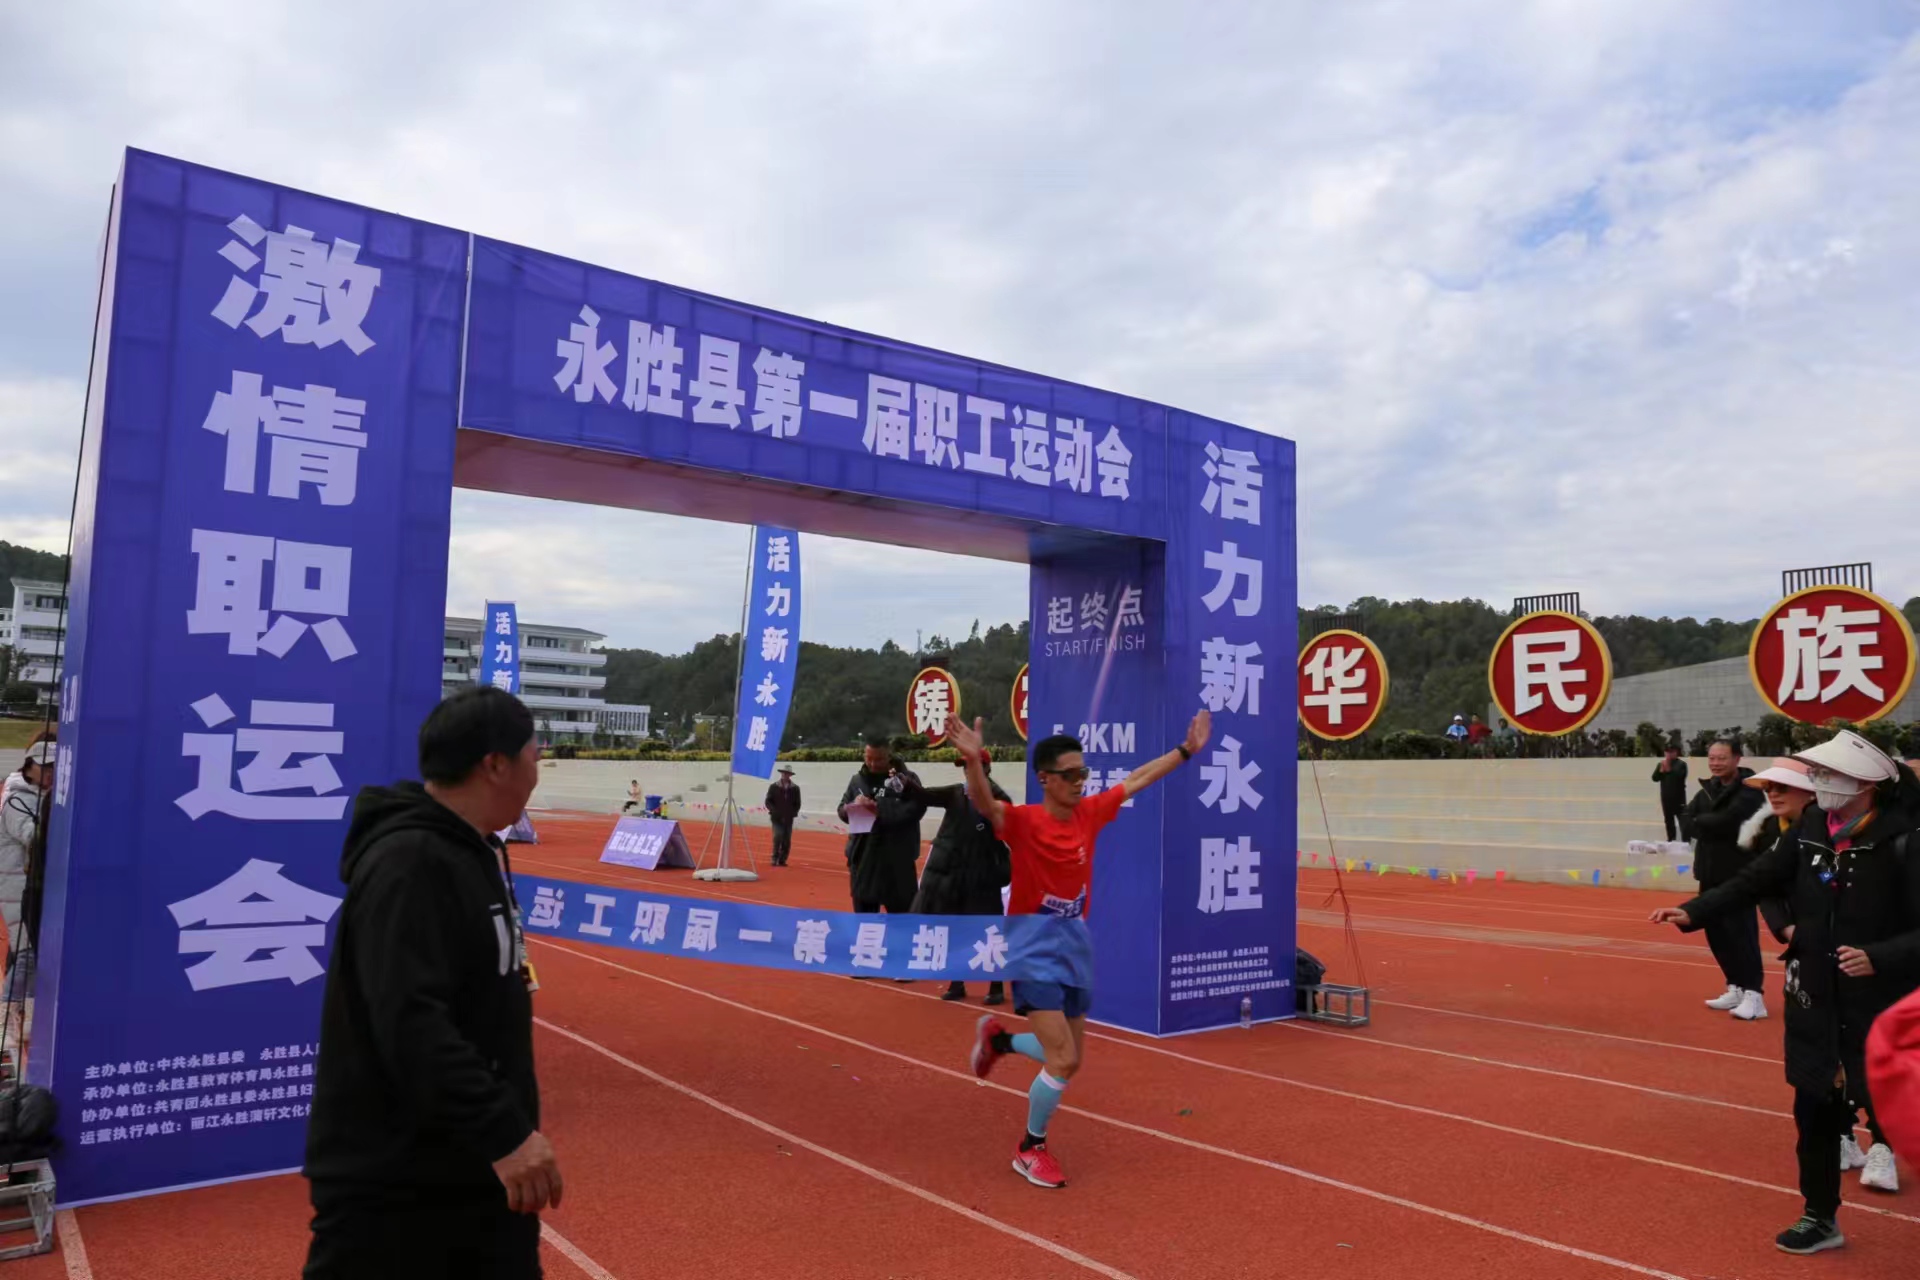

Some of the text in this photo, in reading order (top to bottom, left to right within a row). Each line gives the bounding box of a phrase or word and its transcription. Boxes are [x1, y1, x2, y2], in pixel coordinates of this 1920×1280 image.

[554, 305, 1133, 500] 永胜县第一届职工运动会
[166, 214, 382, 992] 激情职运会
[745, 536, 791, 752] 活力新永胜
[1045, 632, 1146, 657] START/FINISH
[1047, 584, 1145, 635] 起终点
[1199, 440, 1265, 914] 活力新永胜
[1304, 646, 1368, 724] 华
[1513, 628, 1587, 716] 民
[1776, 604, 1884, 706] 族
[914, 678, 949, 736] 铸
[83, 1062, 316, 1101] 承办单位:永胜县教育体育局永胜县
[260, 1042, 320, 1061] 永胜县人
